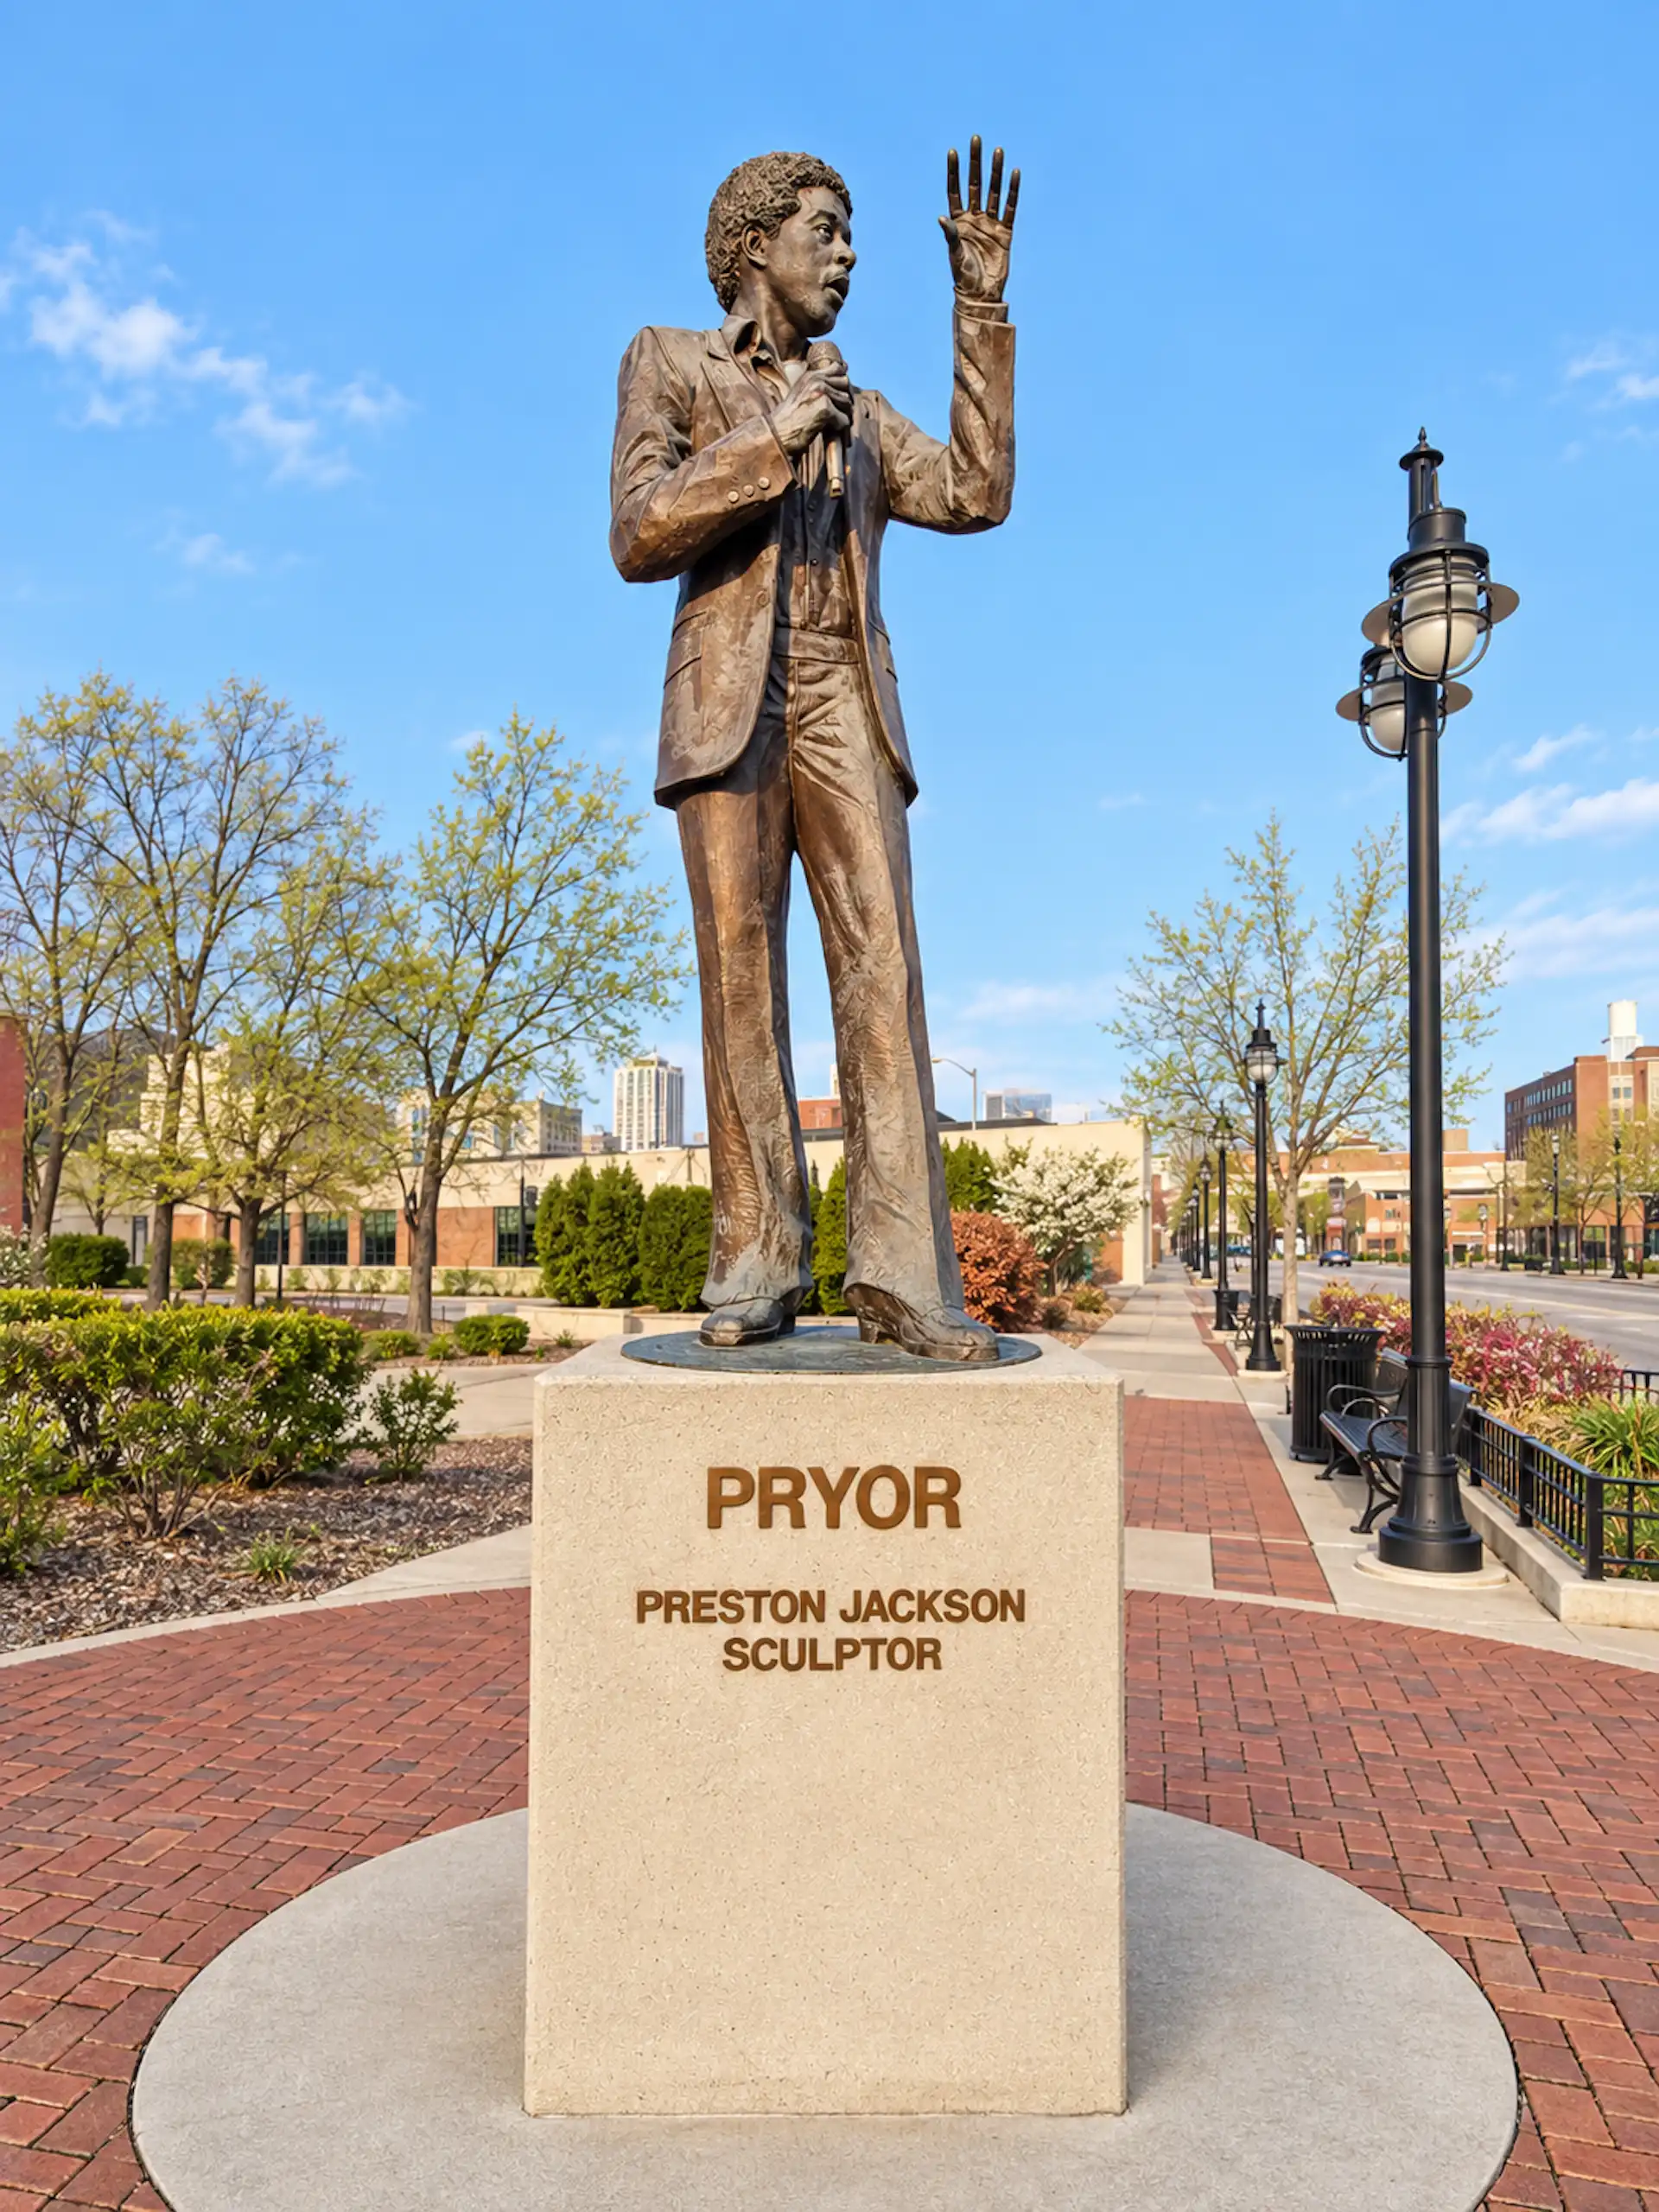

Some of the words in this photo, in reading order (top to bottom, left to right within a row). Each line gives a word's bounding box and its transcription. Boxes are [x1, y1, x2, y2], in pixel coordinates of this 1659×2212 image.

[707, 1465, 962, 1531] PRYOR
[636, 1589, 826, 1624] PRESTON
[839, 1588, 1026, 1624] JACKSON
[721, 1637, 943, 1673] SCULPTOR
